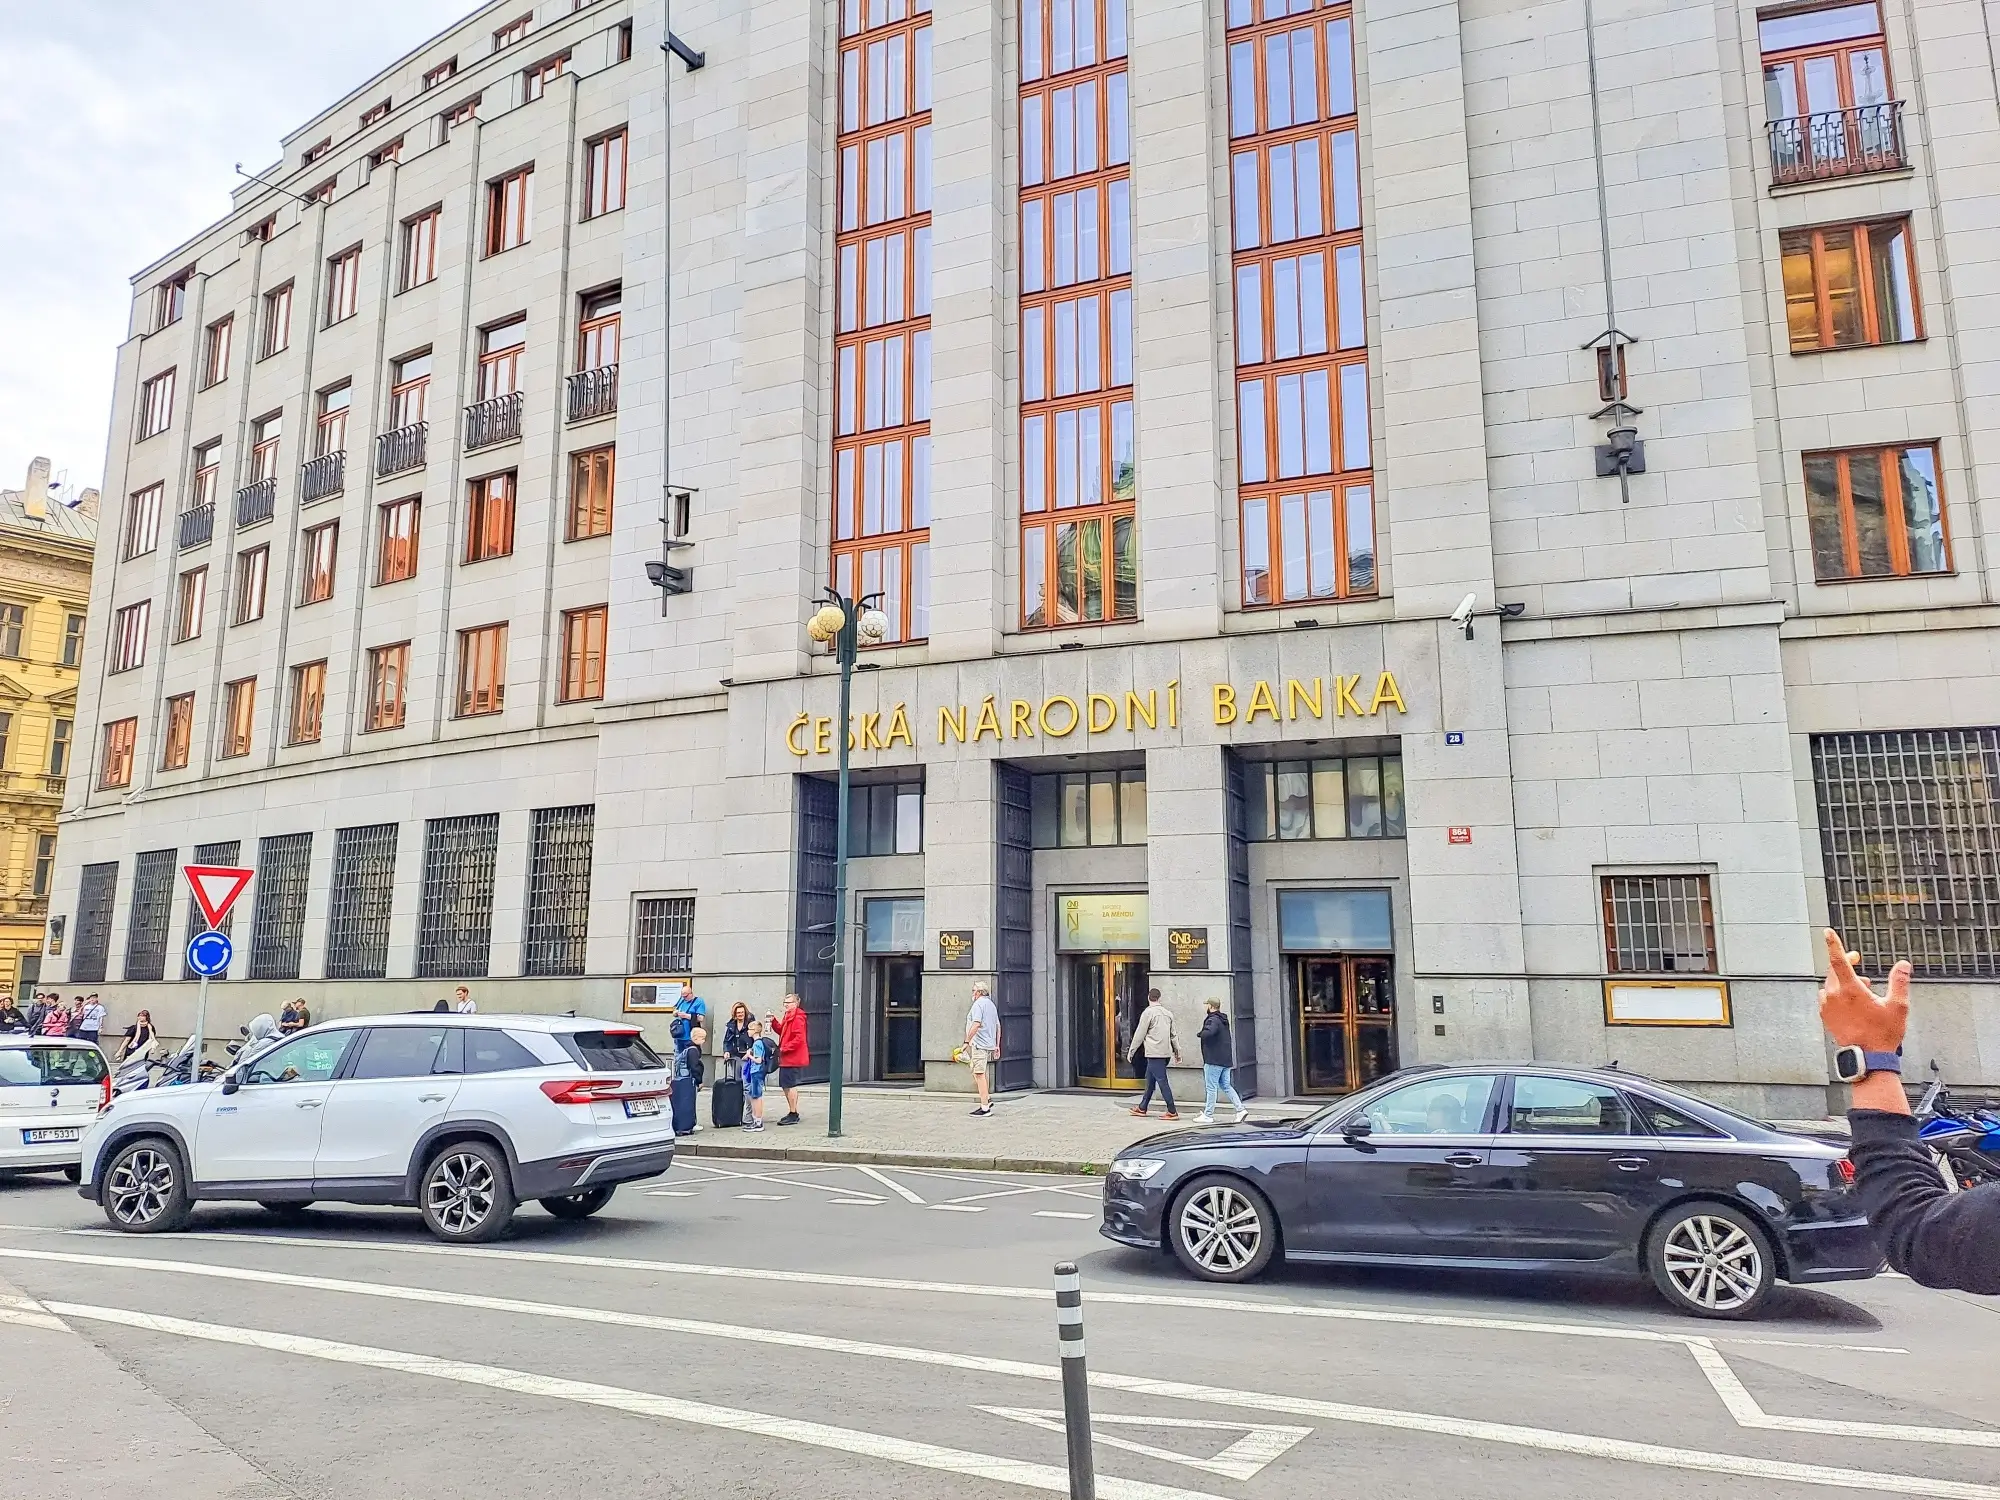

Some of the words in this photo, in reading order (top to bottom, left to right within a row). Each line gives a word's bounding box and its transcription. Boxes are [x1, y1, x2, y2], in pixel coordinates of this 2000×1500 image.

[938, 680, 1178, 744] NÁRODNÍ
[1213, 671, 1408, 724] BANKA
[1449, 735, 1460, 743] 28
[940, 933, 959, 946] ČNB
[1170, 931, 1191, 944] ČNB
[32, 1131, 48, 1140] 5AF
[54, 1129, 75, 1138] 5331
